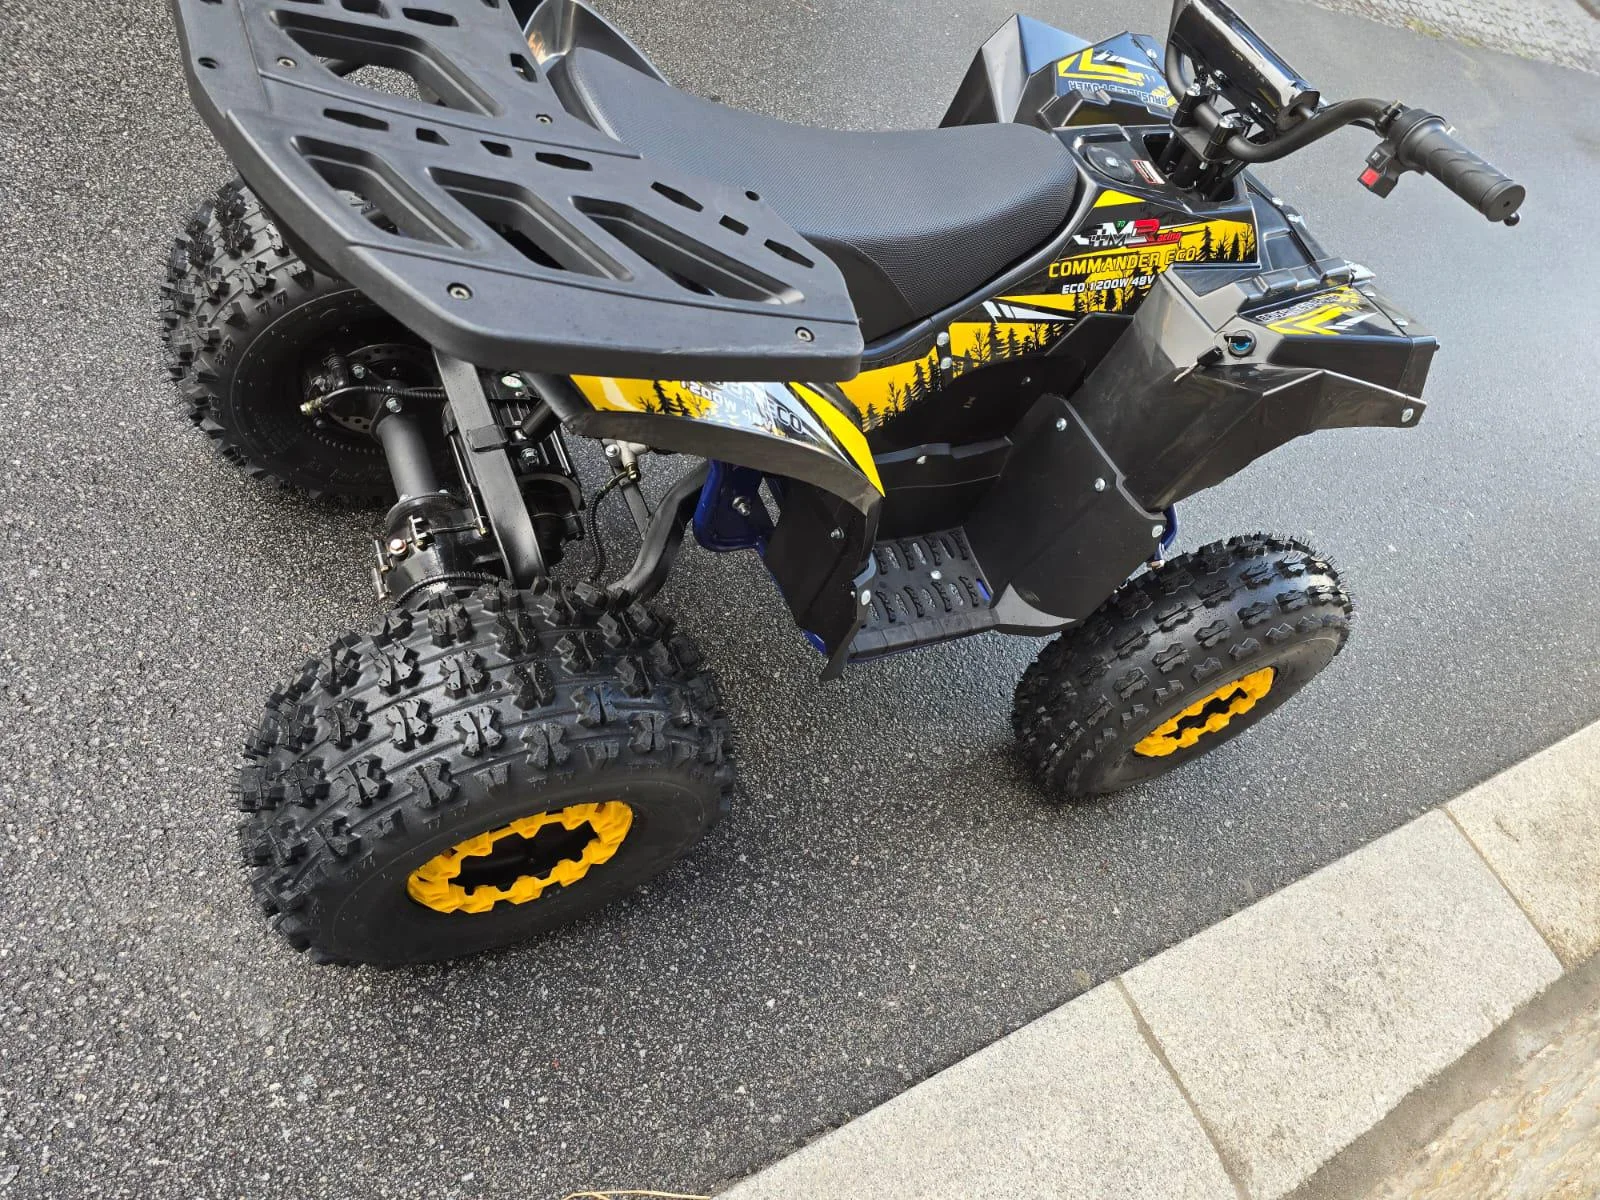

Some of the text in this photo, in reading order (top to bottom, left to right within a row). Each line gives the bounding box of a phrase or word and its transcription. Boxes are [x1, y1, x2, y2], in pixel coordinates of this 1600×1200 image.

[1048, 247, 1197, 279] COMMANDER ECO
[1061, 273, 1156, 295] ECO 1200W 48V
